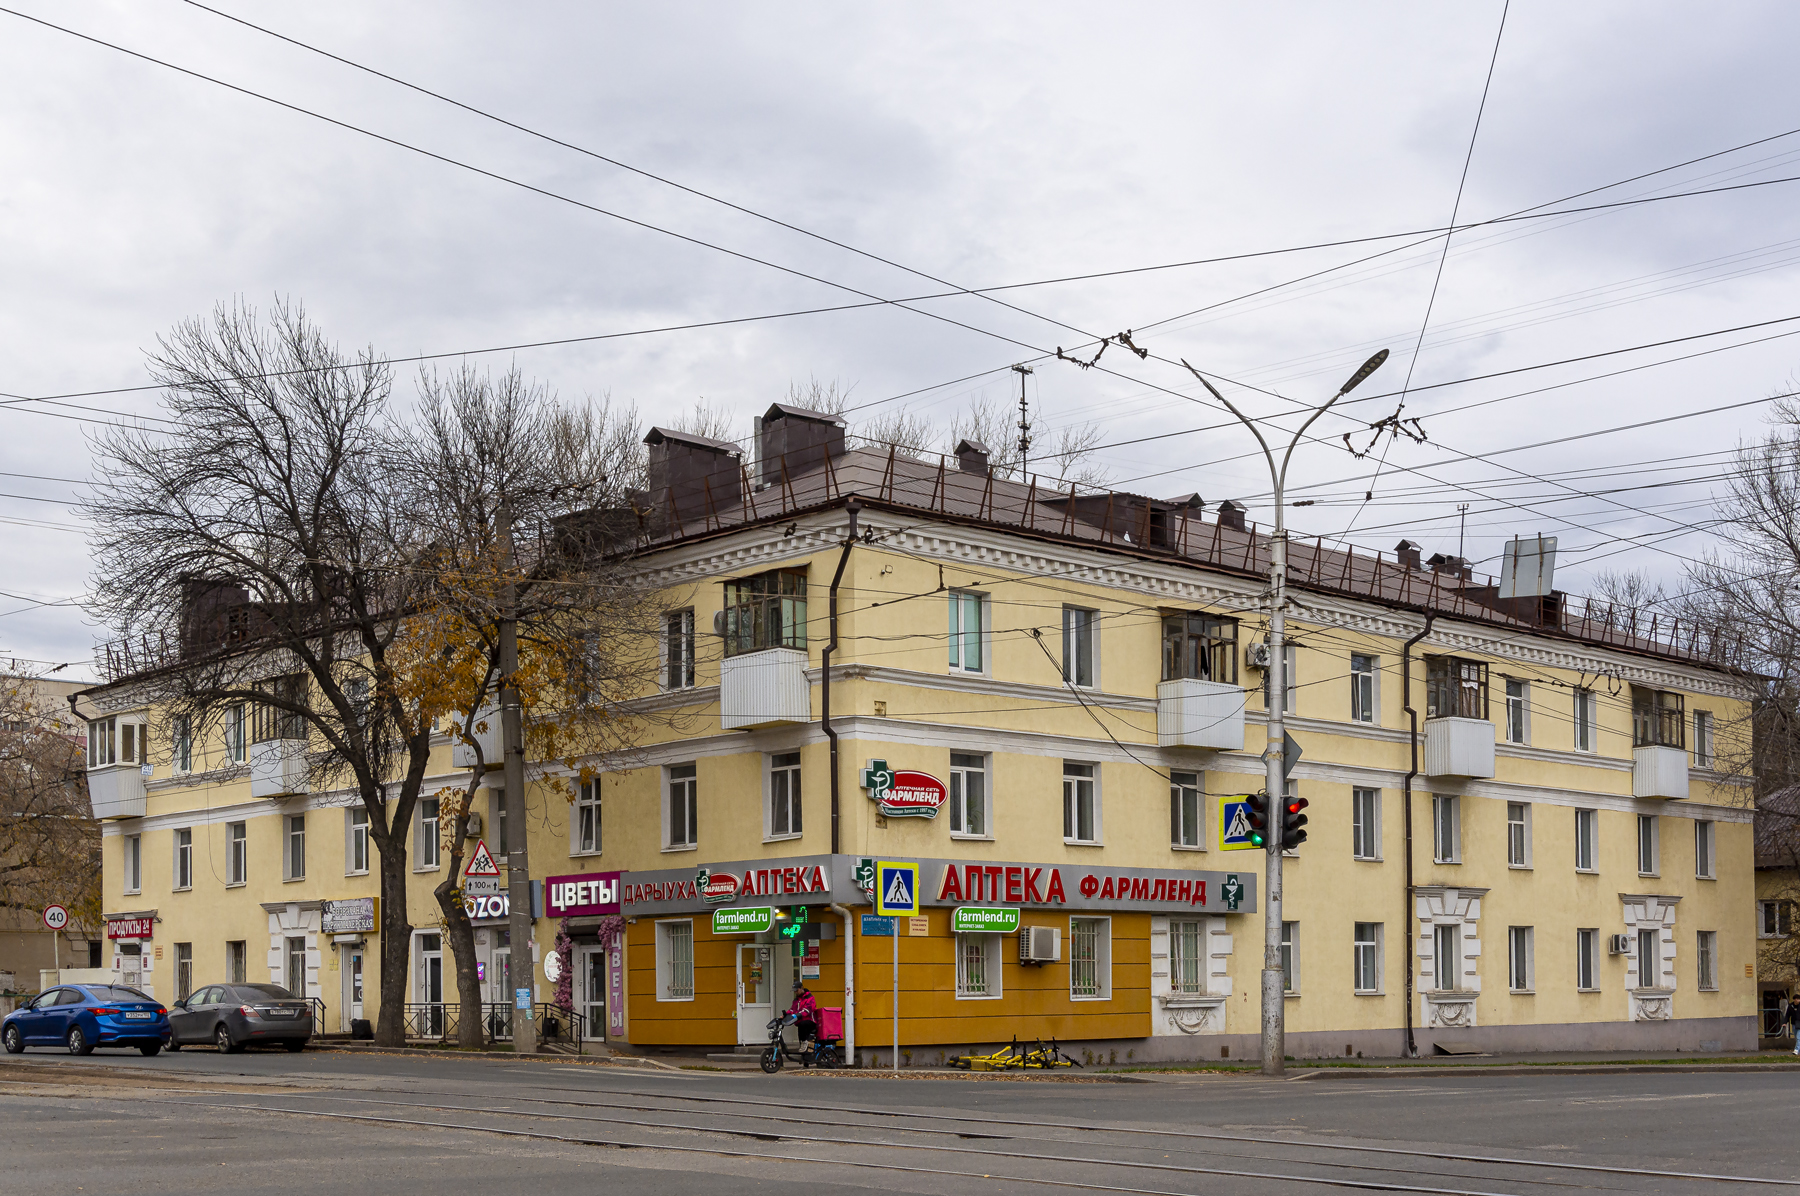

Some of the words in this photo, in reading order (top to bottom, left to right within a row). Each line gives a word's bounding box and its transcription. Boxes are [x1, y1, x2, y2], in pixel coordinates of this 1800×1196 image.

[881, 788, 940, 805] ФАРМЛЕНД
[474, 881, 486, 889] 100
[703, 885, 734, 893] ФАРМЛЕНД
[741, 865, 829, 896] АПТЕКА
[936, 863, 1067, 904] АПТЕКА
[1078, 874, 1207, 906] ФАРМЛЕНД
[551, 879, 619, 912] ЦВЕТЫ
[49, 912, 64, 923] 40
[716, 910, 768, 924] farmlend.ru
[958, 910, 1016, 923] farmlend.ru
[108, 920, 142, 937] ПРОДУКТЫ
[142, 919, 150, 930] 24
[611, 932, 623, 1028] ЦВЕТЫ
